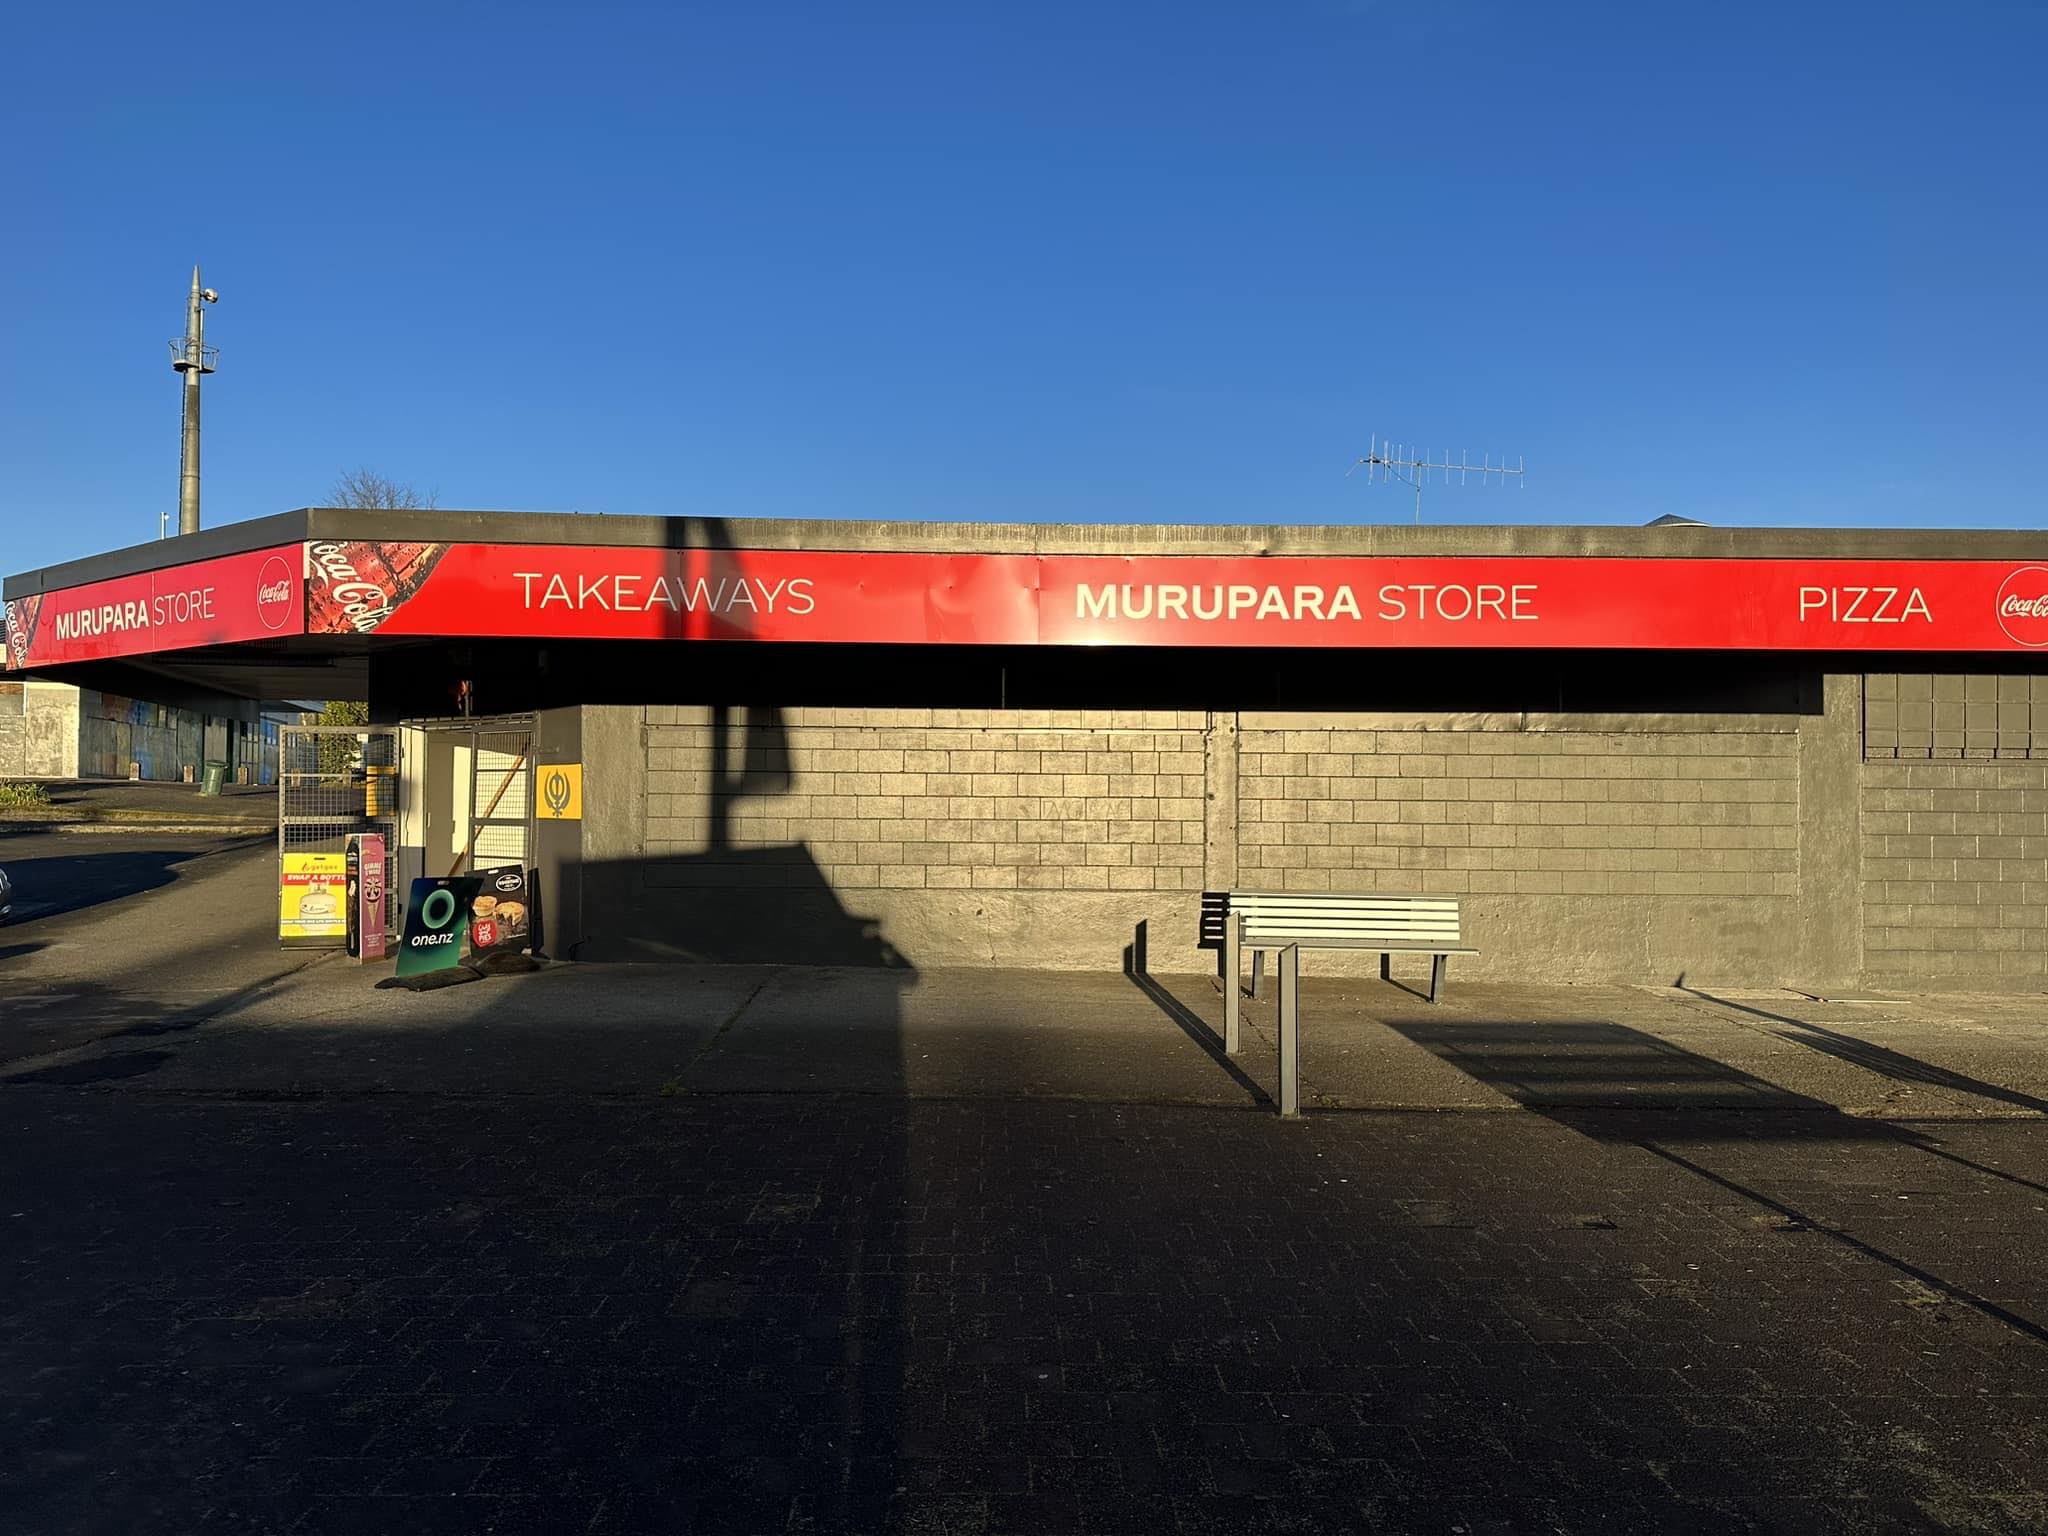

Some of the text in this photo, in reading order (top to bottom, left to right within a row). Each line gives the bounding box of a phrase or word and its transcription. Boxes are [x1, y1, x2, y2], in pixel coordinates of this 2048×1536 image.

[513, 572, 815, 614] TAKEAWAYS
[1076, 583, 1539, 620] MURUPARA STORE
[1800, 587, 1933, 622] PIZZA
[56, 587, 215, 641] MURUPARA STORE
[411, 933, 454, 946] one.nz
